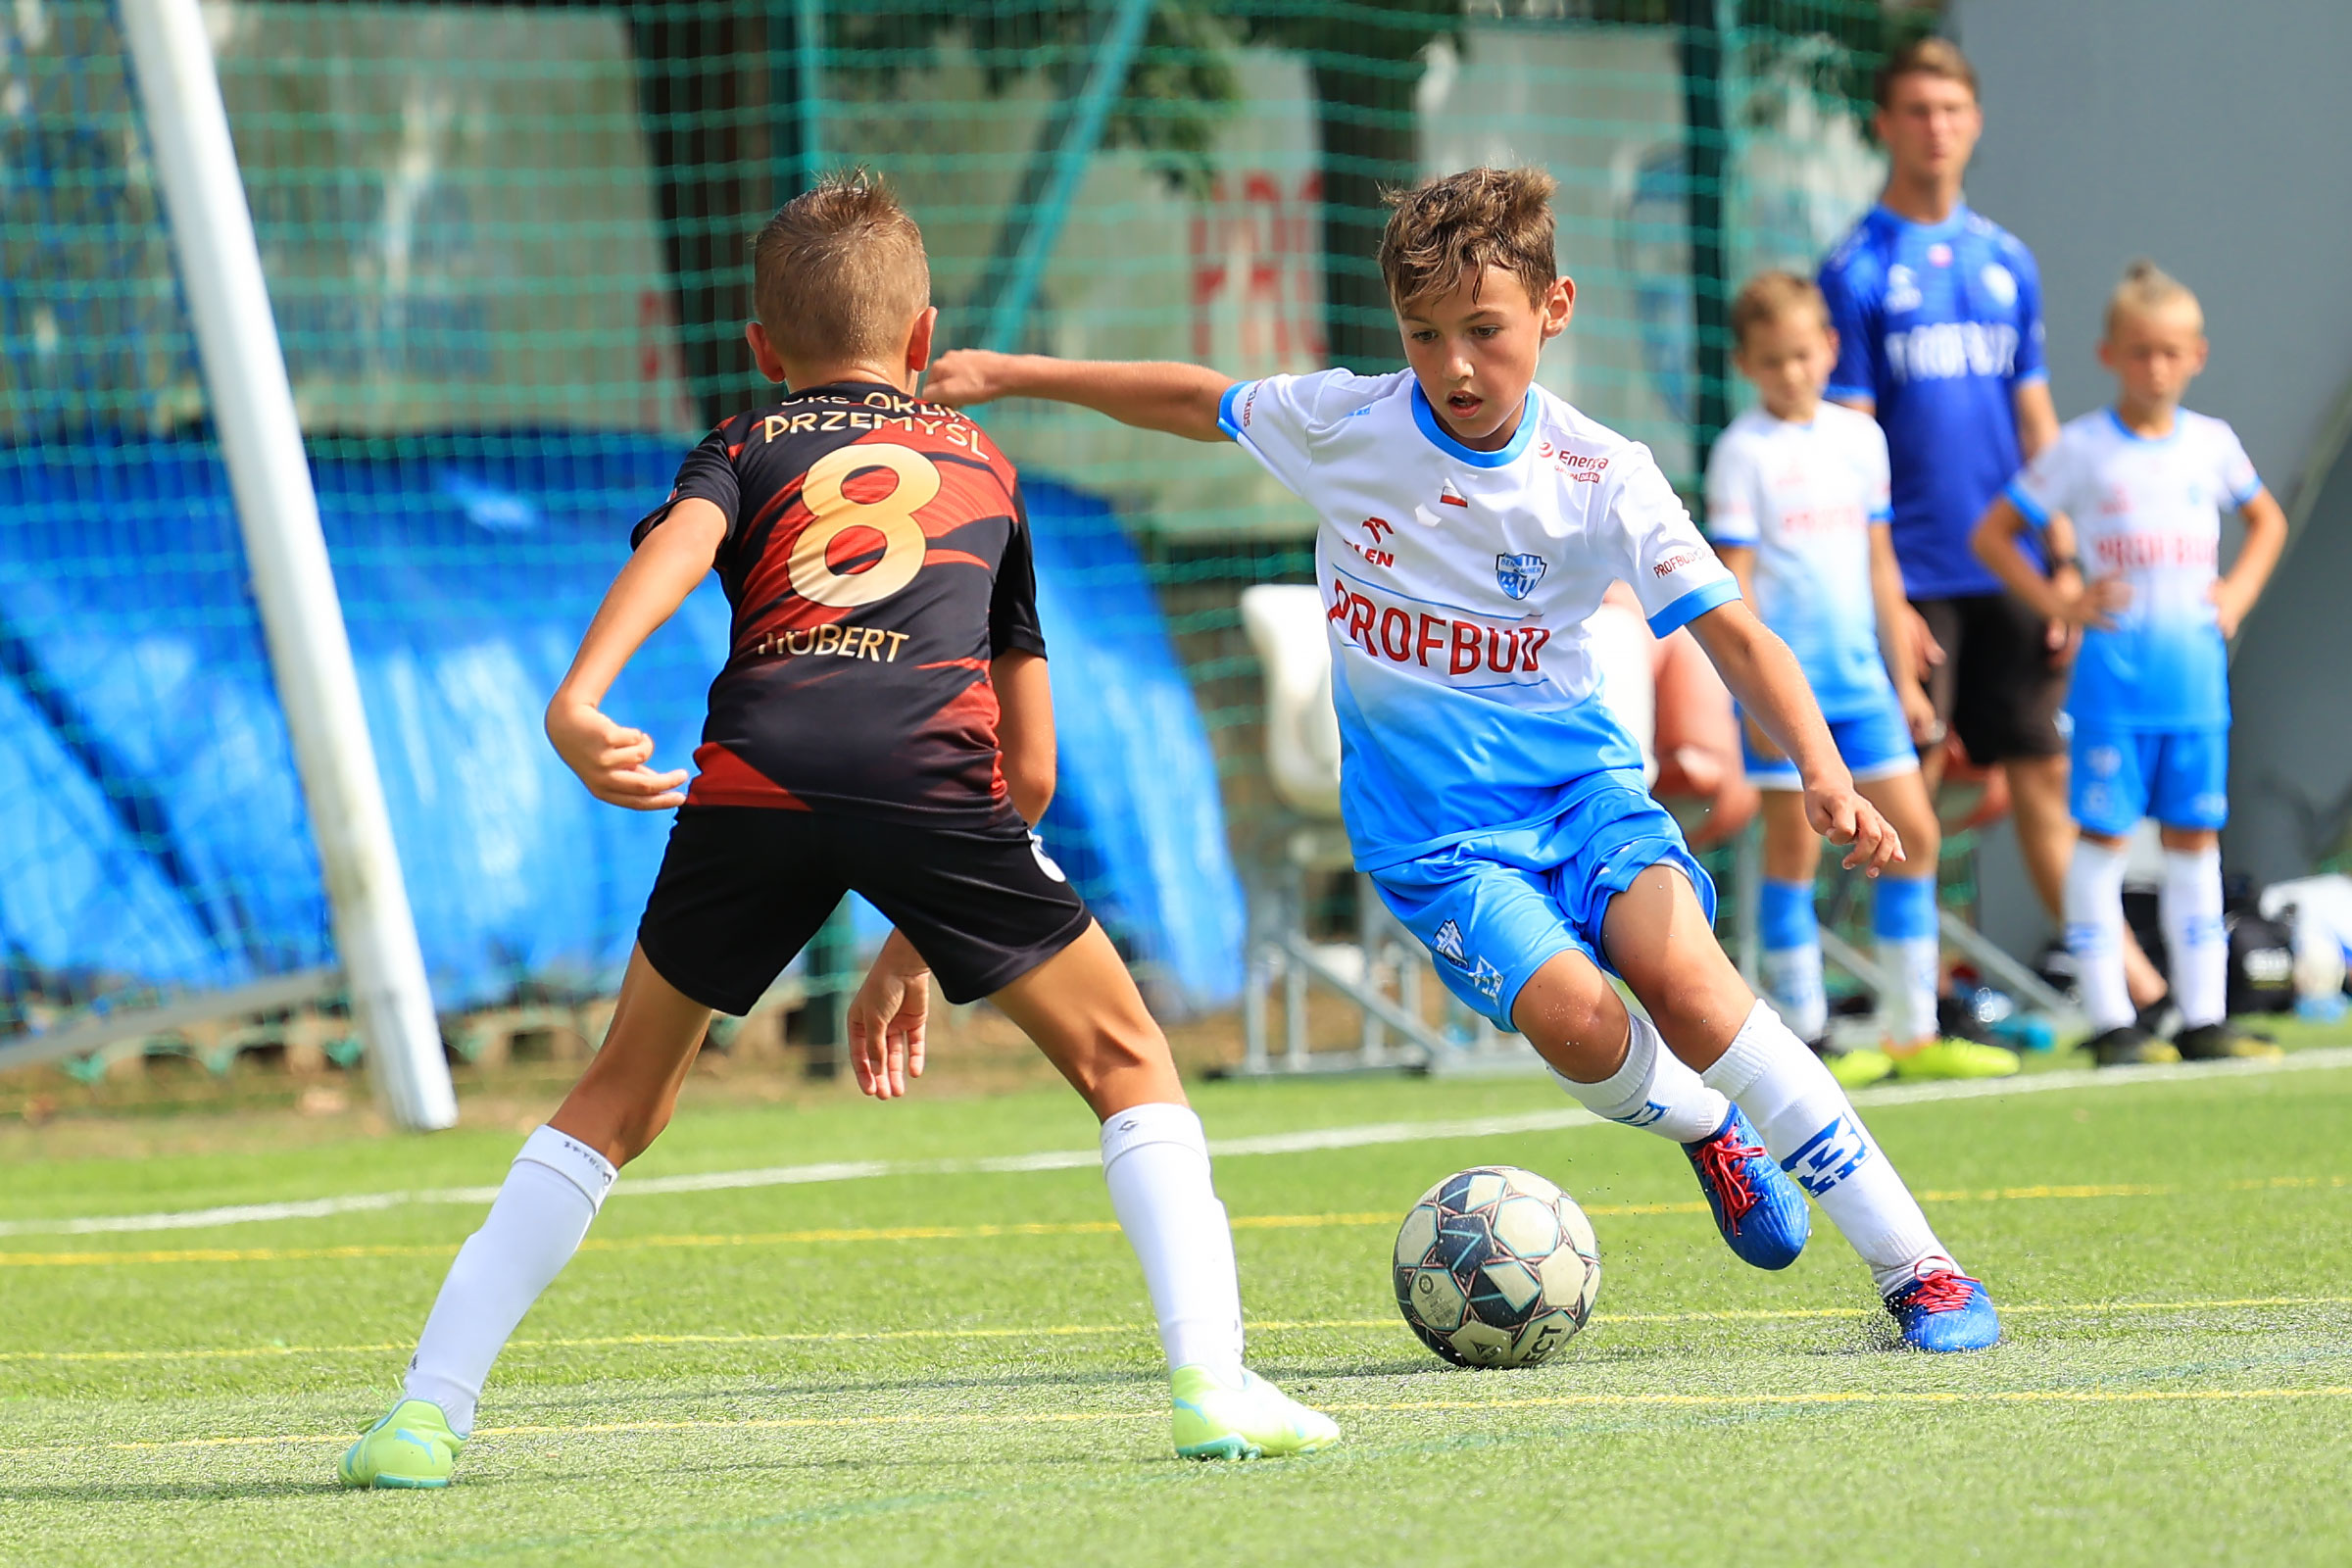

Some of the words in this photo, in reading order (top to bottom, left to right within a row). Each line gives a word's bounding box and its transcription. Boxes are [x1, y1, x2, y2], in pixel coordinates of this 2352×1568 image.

[1558, 450, 1609, 470] Energa
[787, 443, 941, 608] 8
[1653, 552, 1696, 579] PROFBUD
[759, 623, 909, 662] HUBERT
[1328, 578, 1550, 675] PROFBUD
